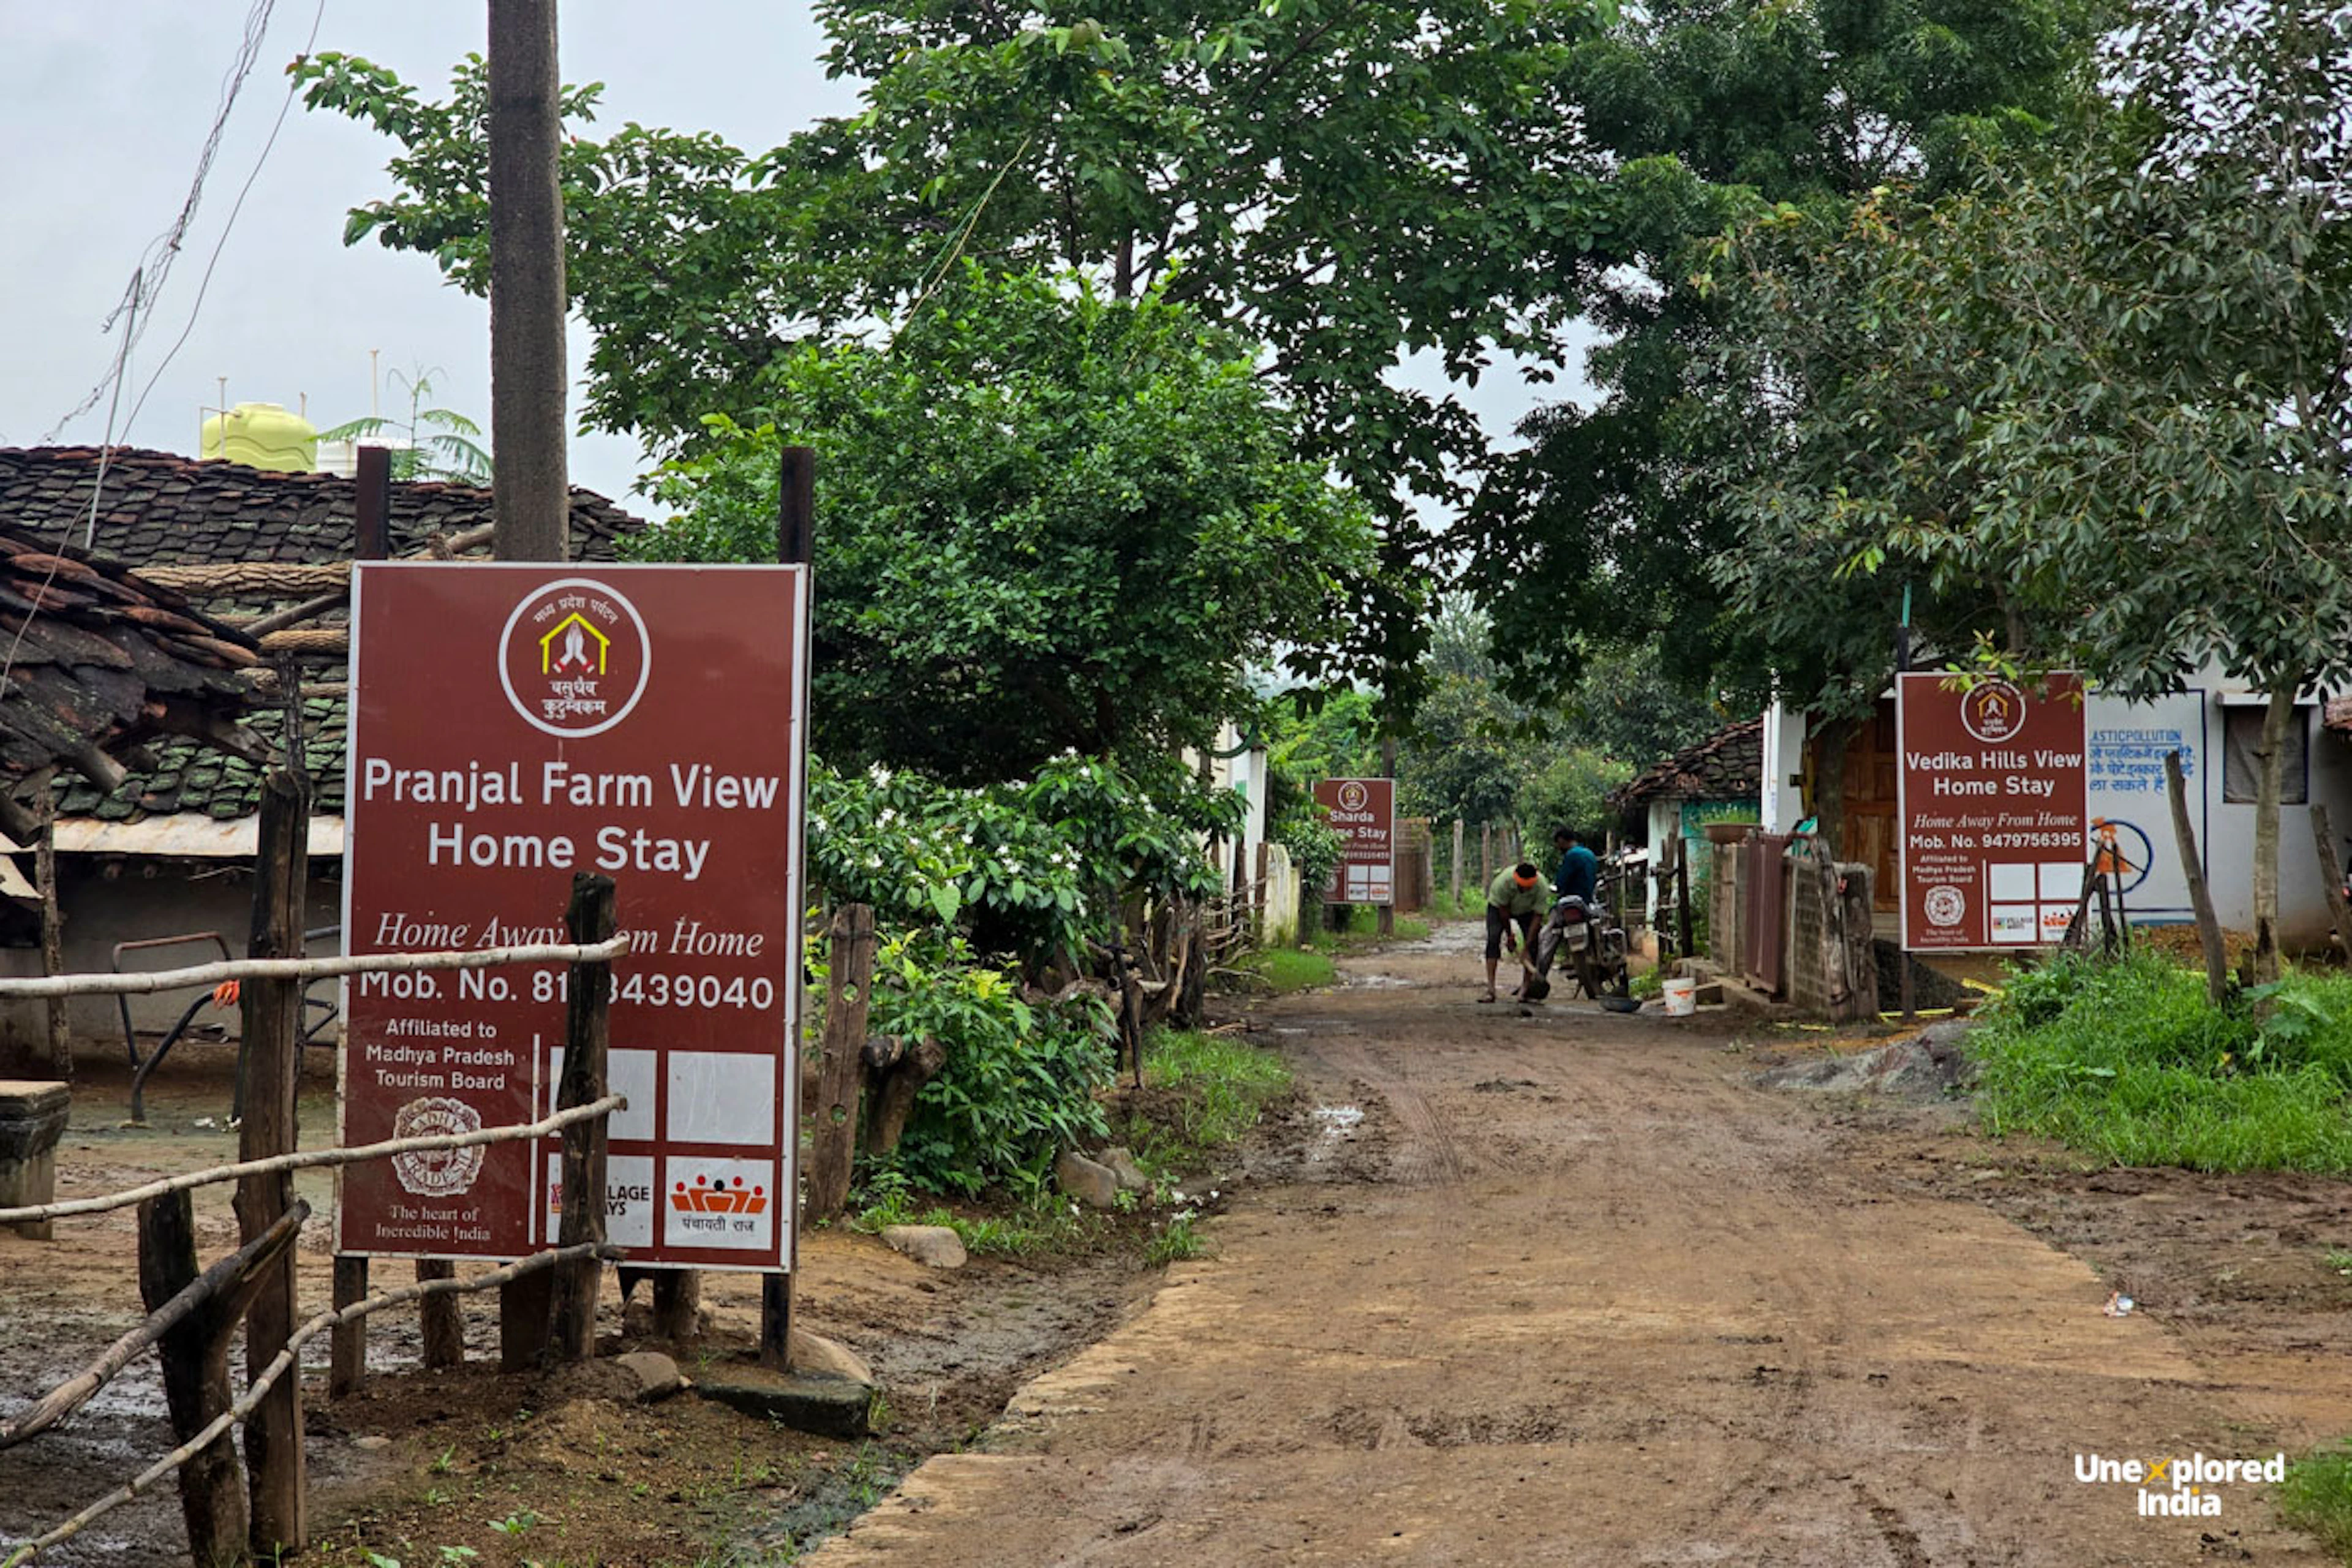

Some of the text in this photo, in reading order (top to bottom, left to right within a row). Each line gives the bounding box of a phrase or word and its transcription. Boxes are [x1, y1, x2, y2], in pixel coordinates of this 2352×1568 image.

[558, 593, 586, 609] प्रदेश
[590, 599, 619, 625] पर्यटन
[1906, 752, 1973, 771] Vedika
[1980, 751, 2027, 769] Hills
[2034, 750, 2082, 768] View
[363, 759, 778, 812] Pranjal Farm View
[1933, 775, 2054, 797] Home Stay
[1330, 810, 1375, 822] Sharda
[1913, 812, 2078, 831] Home Away From Home
[1357, 826, 1387, 841] Stay
[1910, 835, 1945, 849] Mob.
[1951, 834, 1977, 848] No.
[428, 822, 710, 881] Home Stay
[375, 913, 468, 948] Home
[669, 919, 764, 957] Home
[360, 969, 442, 999] Mob.
[459, 968, 518, 1001] No.
[386, 1019, 497, 1038] Affiliated to
[366, 1044, 514, 1066] Madhya Pradesh
[375, 1069, 505, 1090] Tourism Board
[606, 1185, 650, 1201] LAGE
[390, 1205, 481, 1222] The heart of
[682, 1215, 755, 1232] पंचायती राज
[375, 1223, 450, 1240] Incredible
